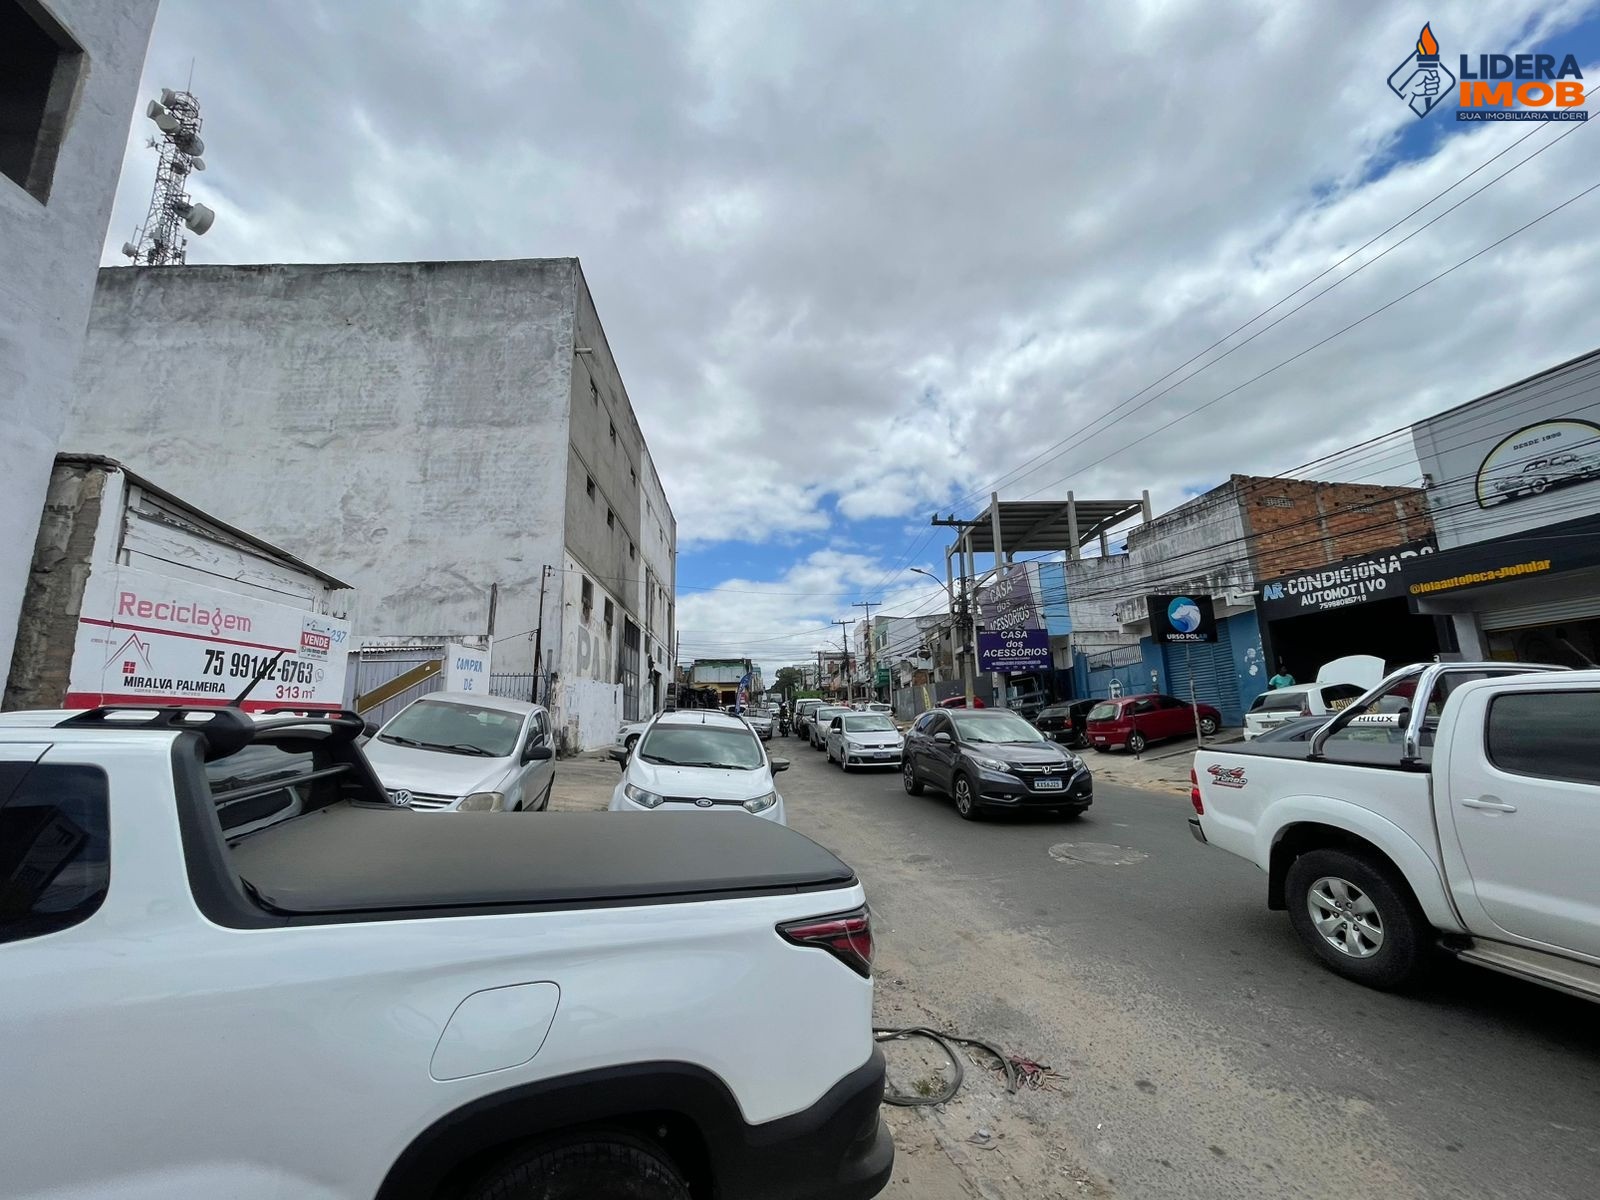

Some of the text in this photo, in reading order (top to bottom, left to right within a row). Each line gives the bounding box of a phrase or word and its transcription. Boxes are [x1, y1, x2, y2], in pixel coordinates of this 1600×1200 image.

[990, 580, 1013, 603] CASA
[1301, 578, 1387, 607] AUTOMOTIVO
[118, 592, 253, 636] Reciclagem
[304, 634, 329, 648] VENDE
[1000, 630, 1028, 639] CASA
[1006, 640, 1023, 648] dos
[203, 649, 225, 676] 75
[456, 657, 483, 672] COMPRA
[123, 676, 226, 693] MIRALVA PALMEIRA
[276, 685, 299, 699] 313
